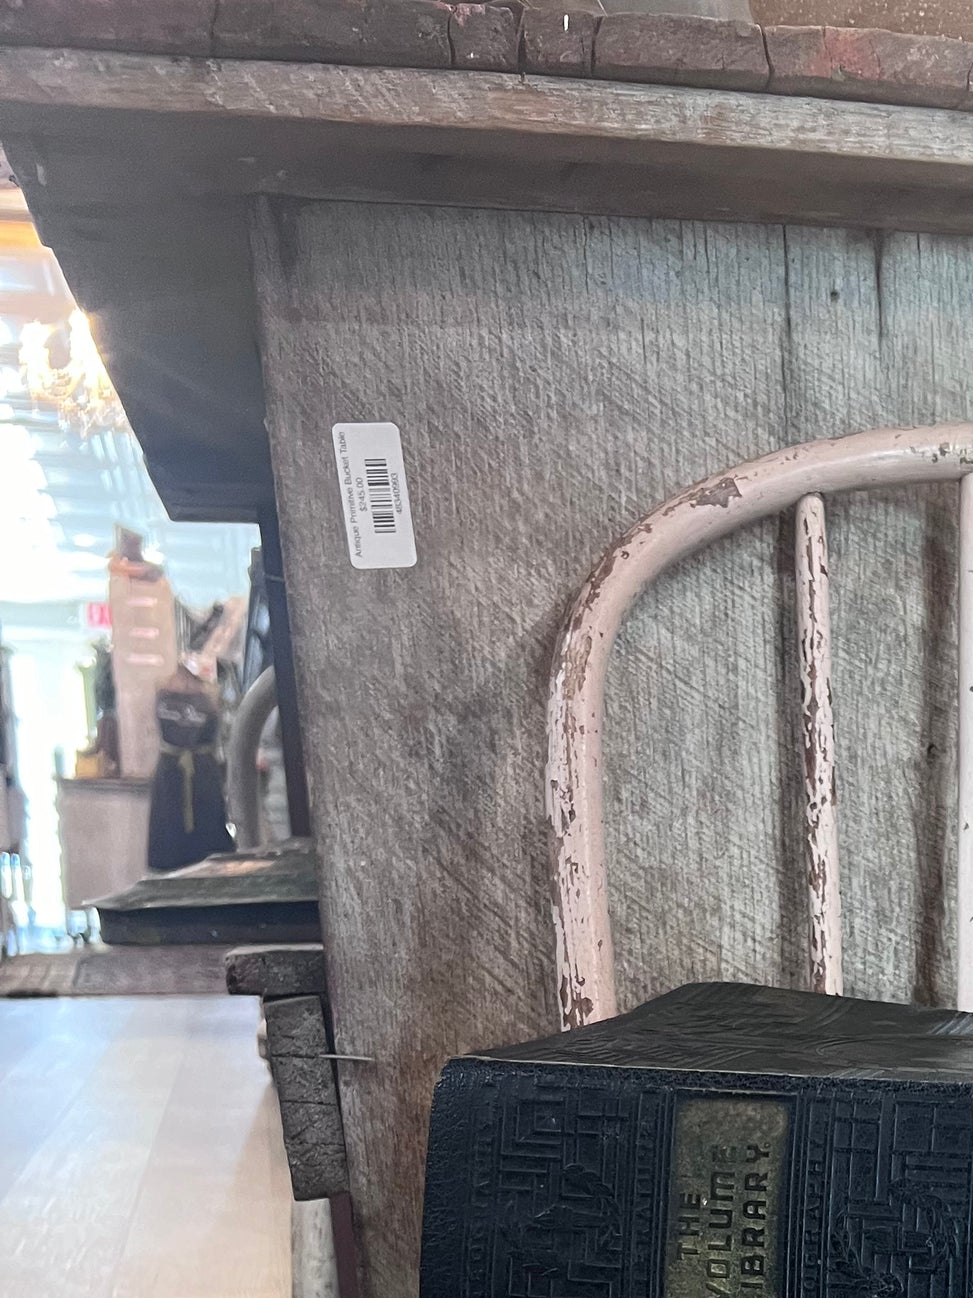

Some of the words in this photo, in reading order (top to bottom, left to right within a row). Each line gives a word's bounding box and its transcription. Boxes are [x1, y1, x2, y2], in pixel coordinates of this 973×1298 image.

[338, 431, 348, 454] Table
[342, 455, 353, 485] Bucket
[347, 488, 358, 524] Primitive
[355, 476, 368, 512] $245.00
[352, 525, 363, 558] Antique
[677, 1192, 701, 1261] THE
